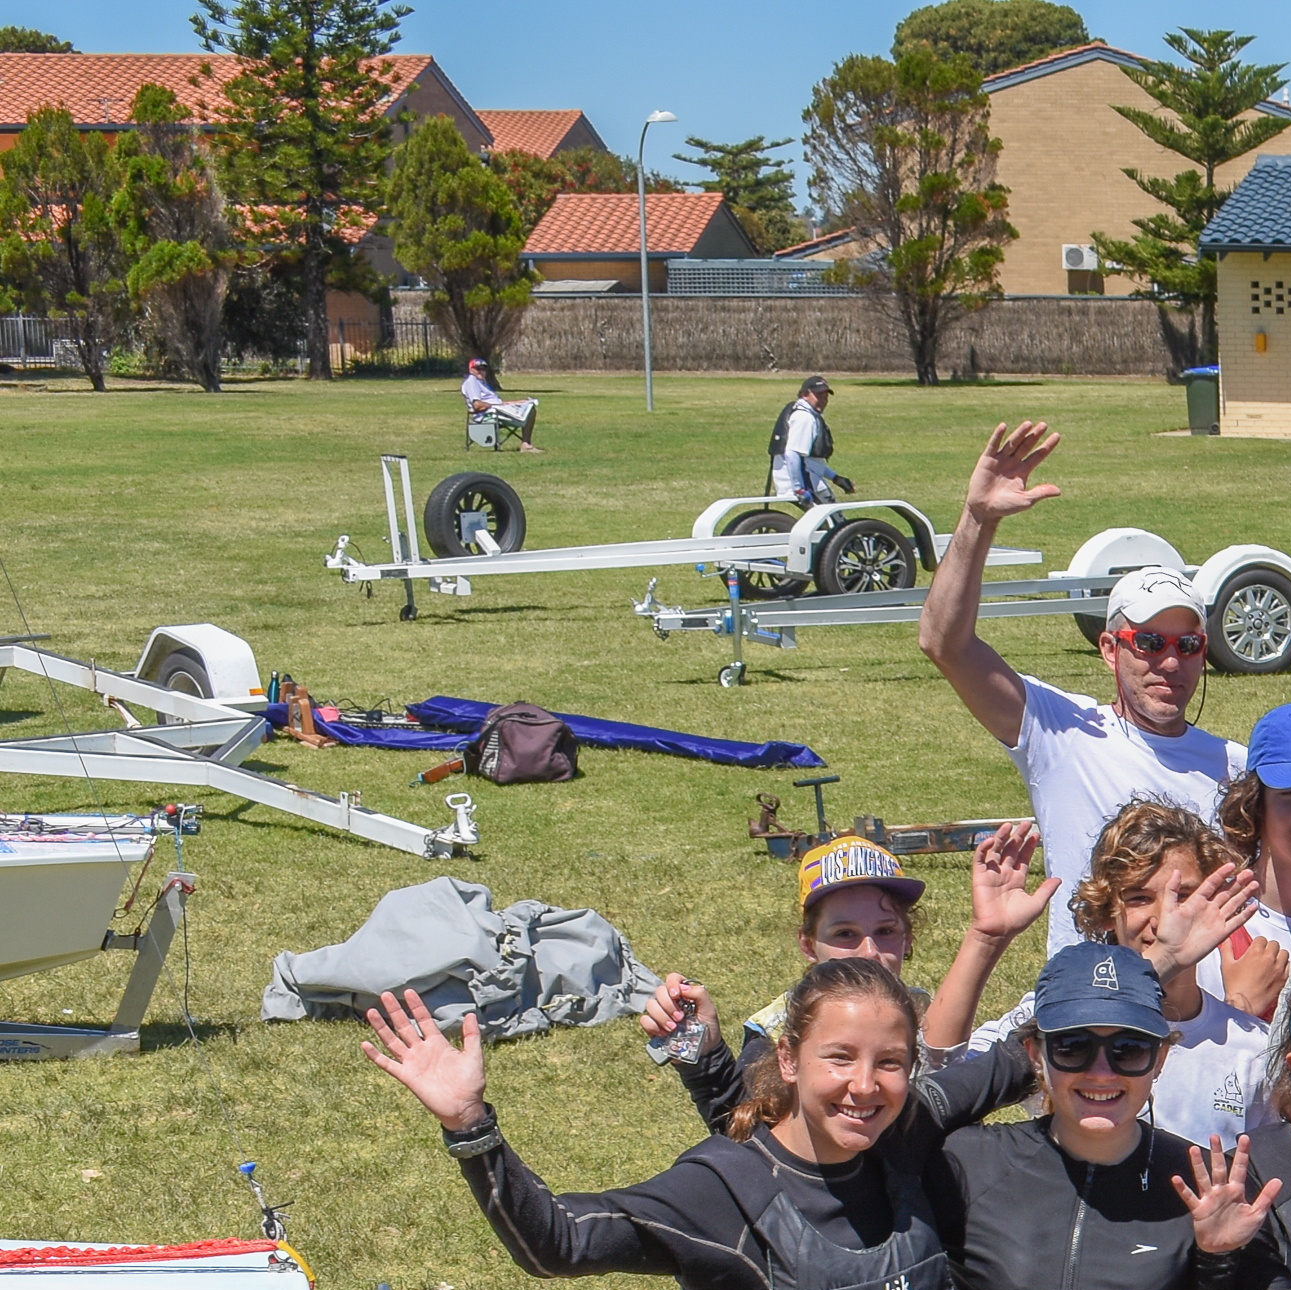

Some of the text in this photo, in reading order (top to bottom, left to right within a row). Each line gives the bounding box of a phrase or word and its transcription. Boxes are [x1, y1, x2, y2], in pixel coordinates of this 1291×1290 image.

[821, 845, 896, 885] LOS ANGELES
[1213, 1103, 1244, 1114] CADET
